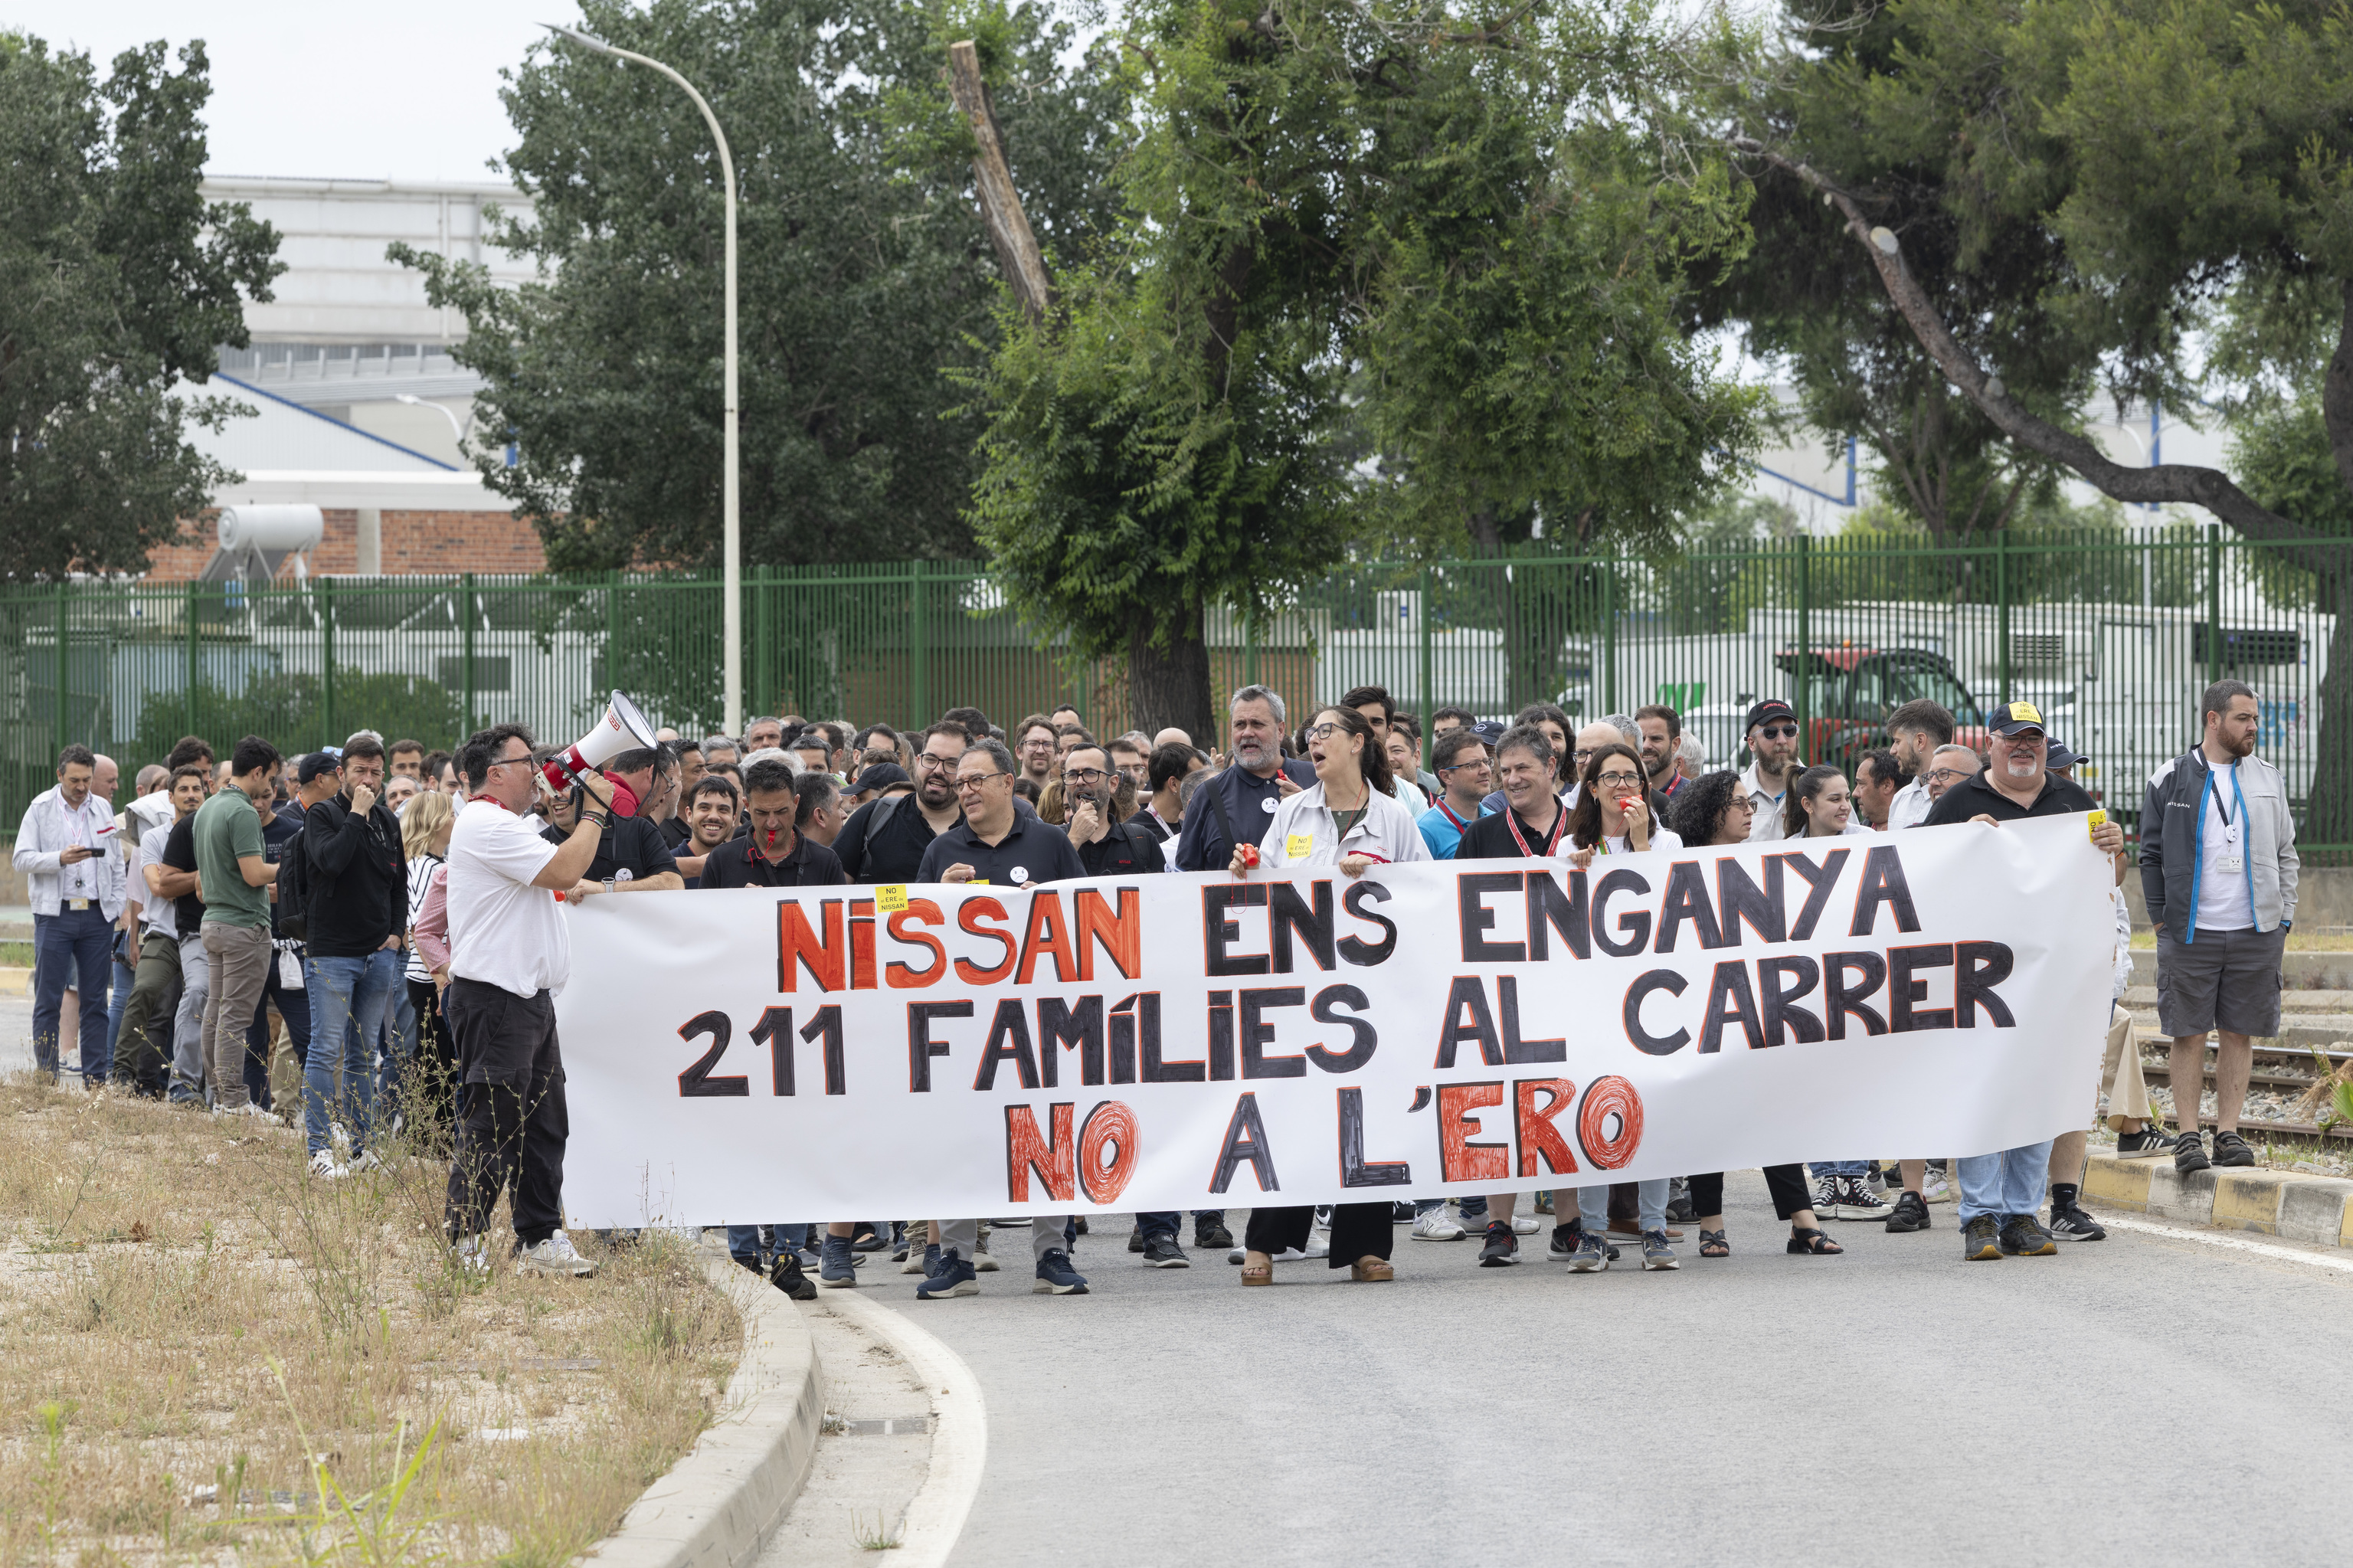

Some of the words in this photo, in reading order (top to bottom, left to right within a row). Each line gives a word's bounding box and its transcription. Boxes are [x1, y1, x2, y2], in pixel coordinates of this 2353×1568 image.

[881, 902, 905, 911] NISSAN
[1201, 880, 1398, 977] ENS
[1458, 845, 1922, 963] ENGANYA
[677, 1004, 846, 1098] 211
[1434, 975, 1567, 1069] AL
[1623, 941, 2017, 1056] CARRER
[1004, 1100, 1142, 1205] NO
[1209, 1092, 1281, 1194] A
[1337, 1075, 1645, 1188] L'ERO
